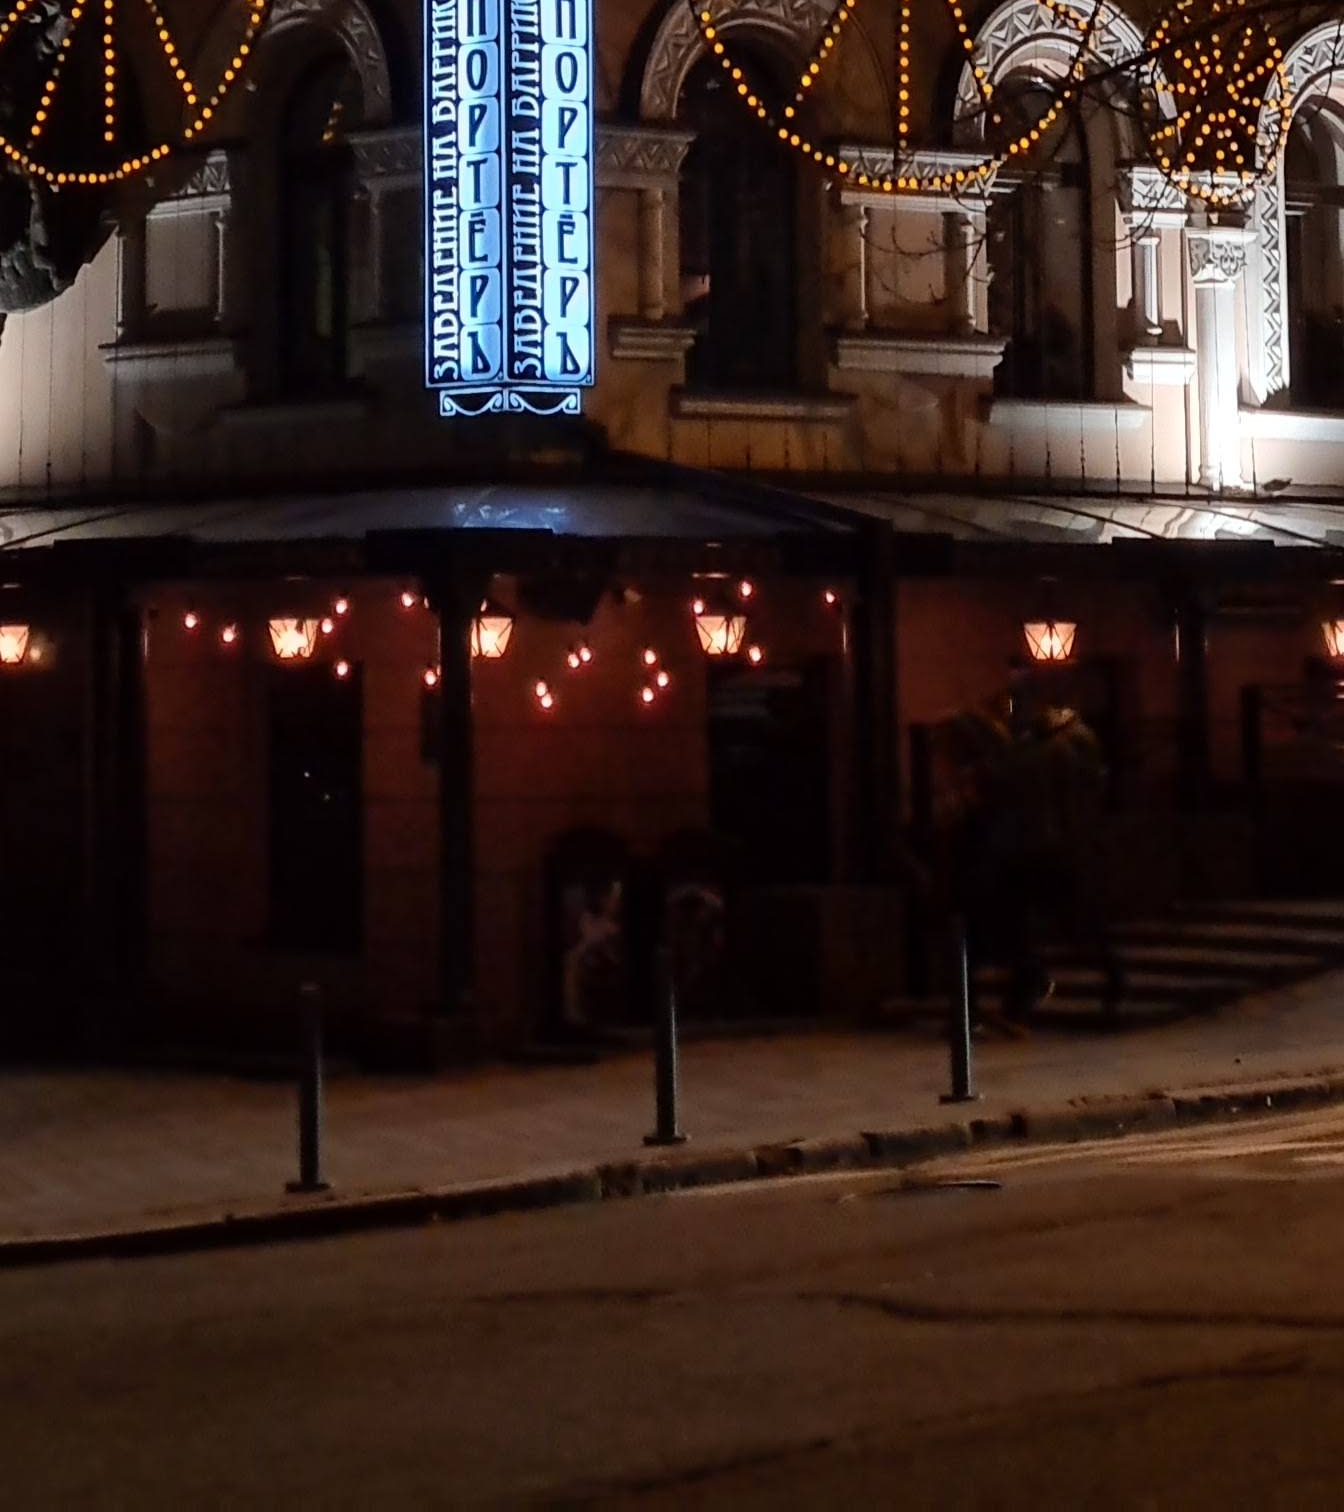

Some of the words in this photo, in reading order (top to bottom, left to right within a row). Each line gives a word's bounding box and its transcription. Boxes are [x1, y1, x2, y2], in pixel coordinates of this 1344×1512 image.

[432, 132, 457, 180] НА
[511, 128, 540, 175] НА
[432, 186, 458, 380] ЗАВЕДЕНИЕ
[513, 183, 542, 378] ЗАВЕДЕНИЕ
